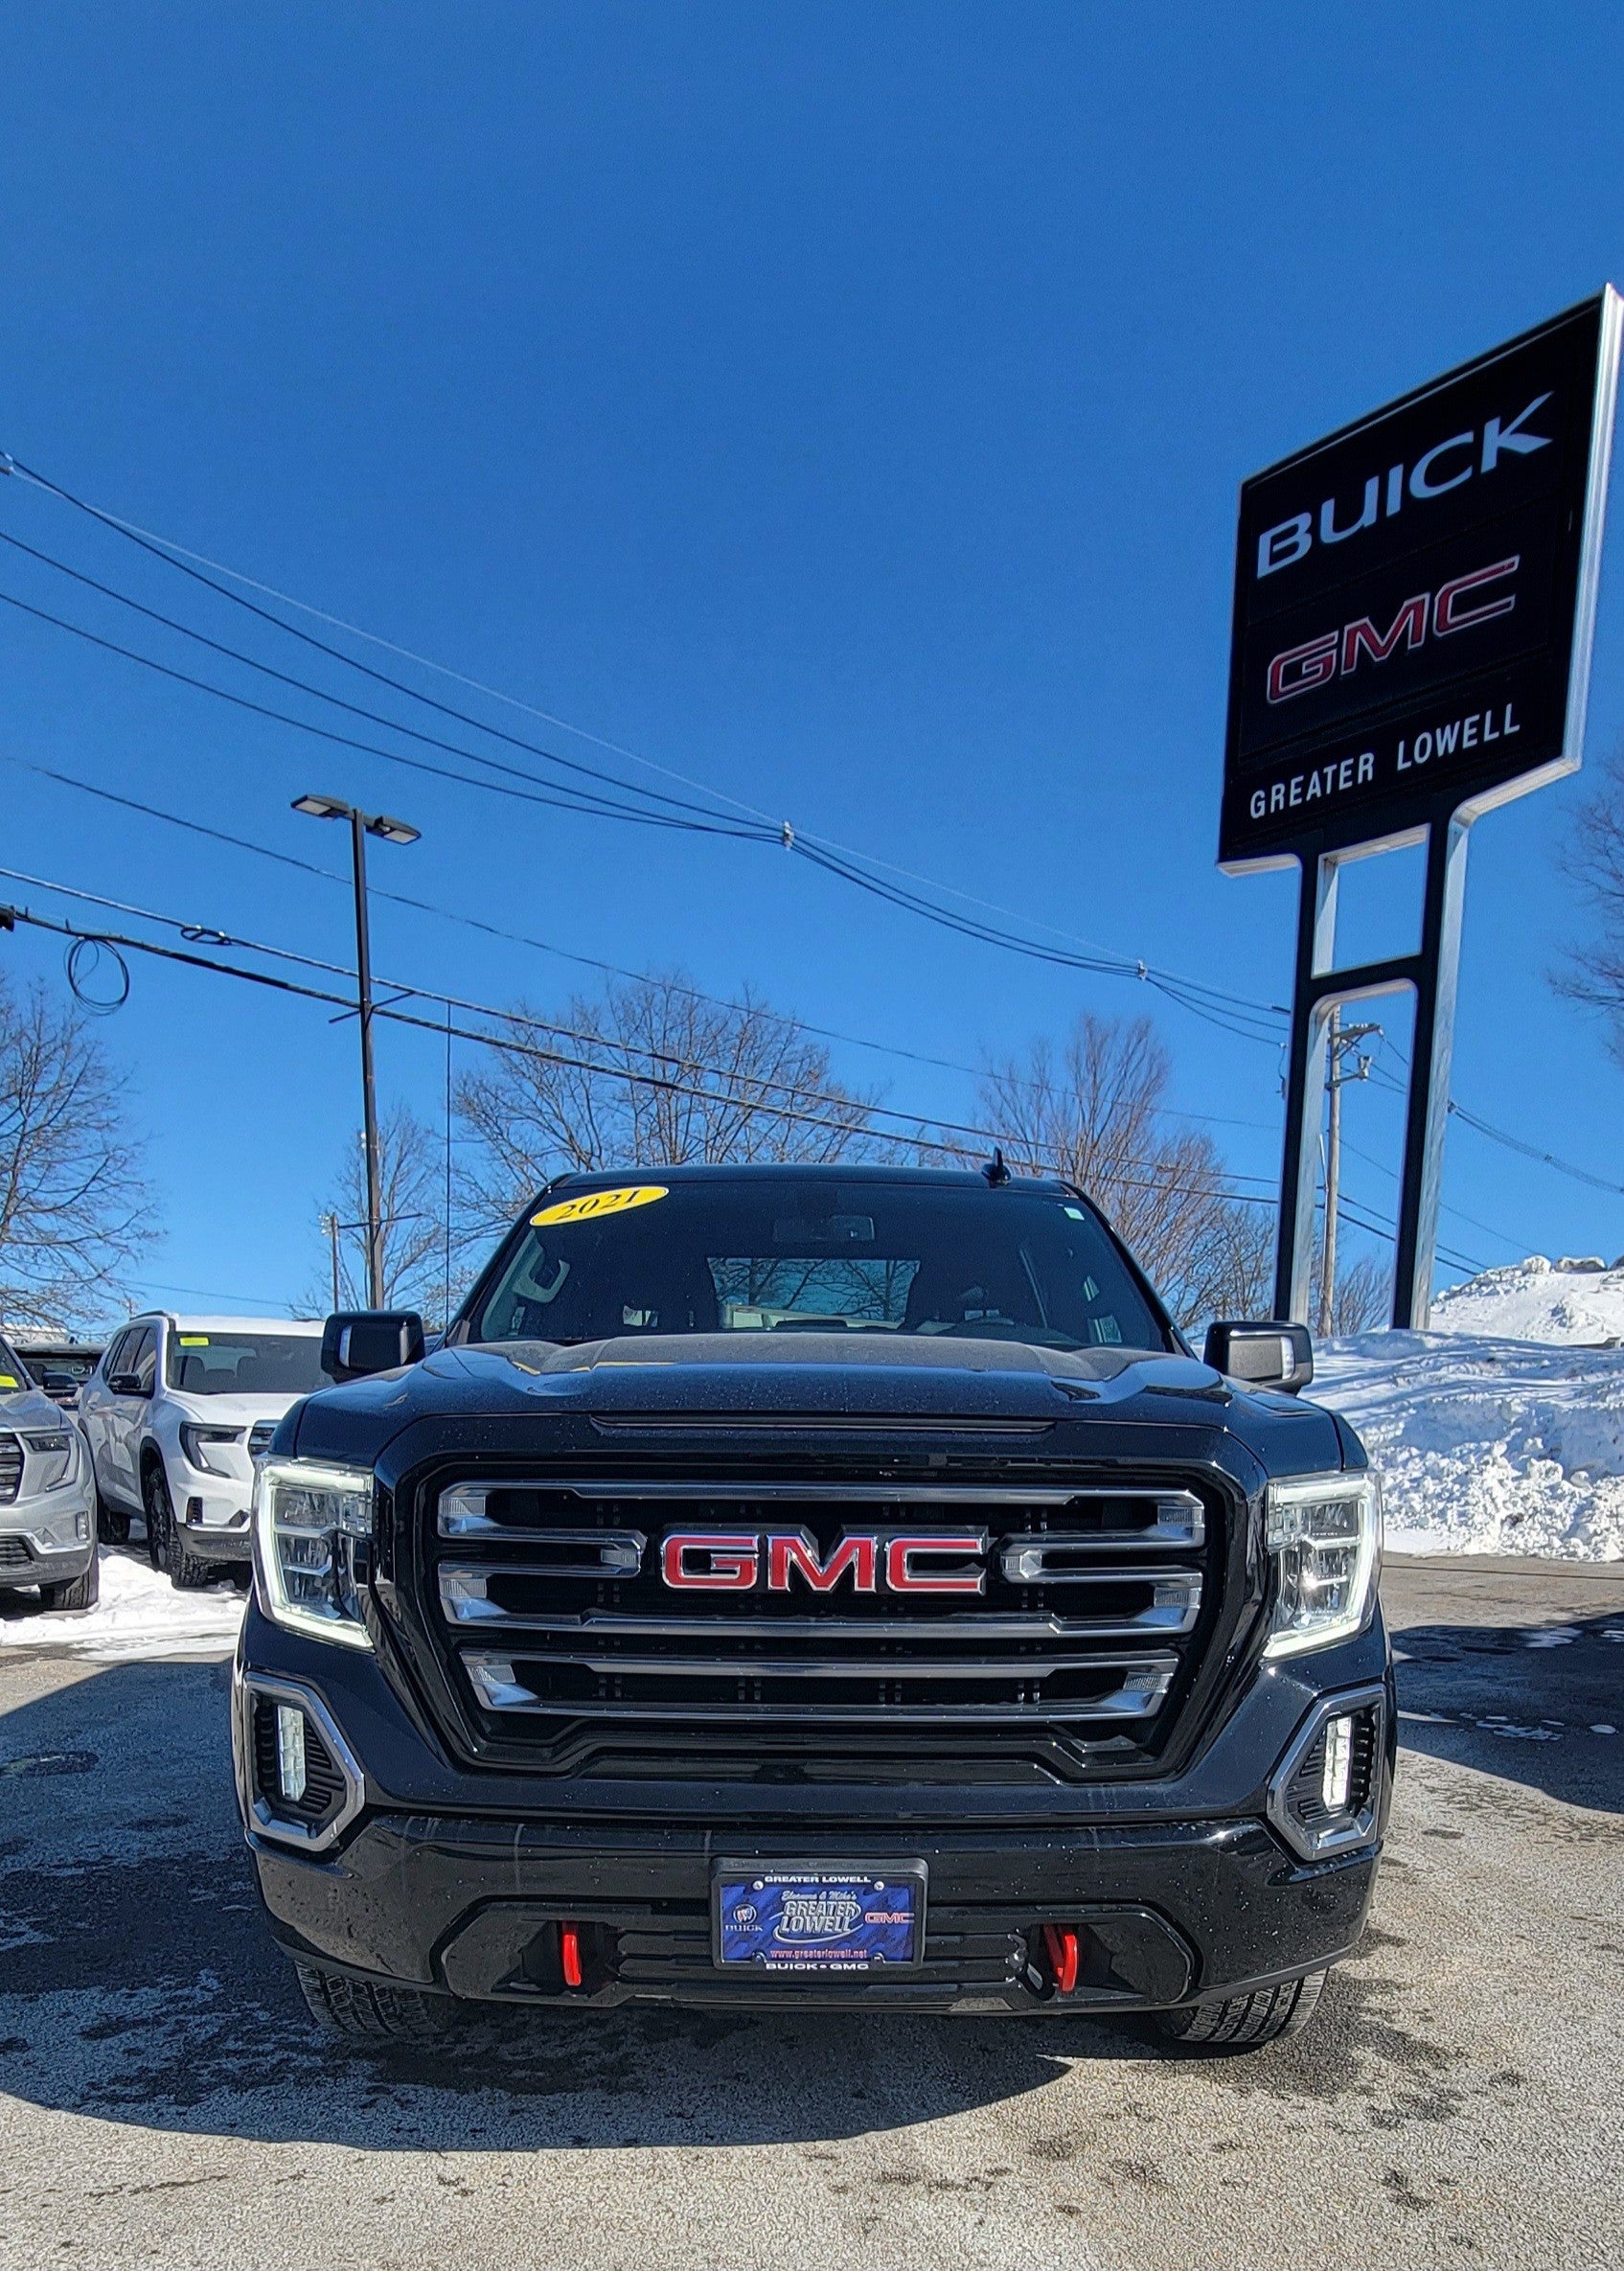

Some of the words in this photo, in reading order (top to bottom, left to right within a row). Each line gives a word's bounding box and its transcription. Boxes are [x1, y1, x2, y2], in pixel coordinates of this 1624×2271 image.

[1257, 391, 1554, 579] BUICK
[1267, 554, 1521, 704] GMC
[1249, 751, 1375, 819] GREATER
[1396, 702, 1521, 771] LOWELL
[555, 1190, 640, 1222] 2021
[661, 1529, 986, 1595] GMC
[784, 1901, 856, 1916] GREATER
[865, 1912, 915, 1923] GMC
[780, 1916, 852, 1934] LOWELL
[770, 1949, 868, 1960] www.greaterlowell.net
